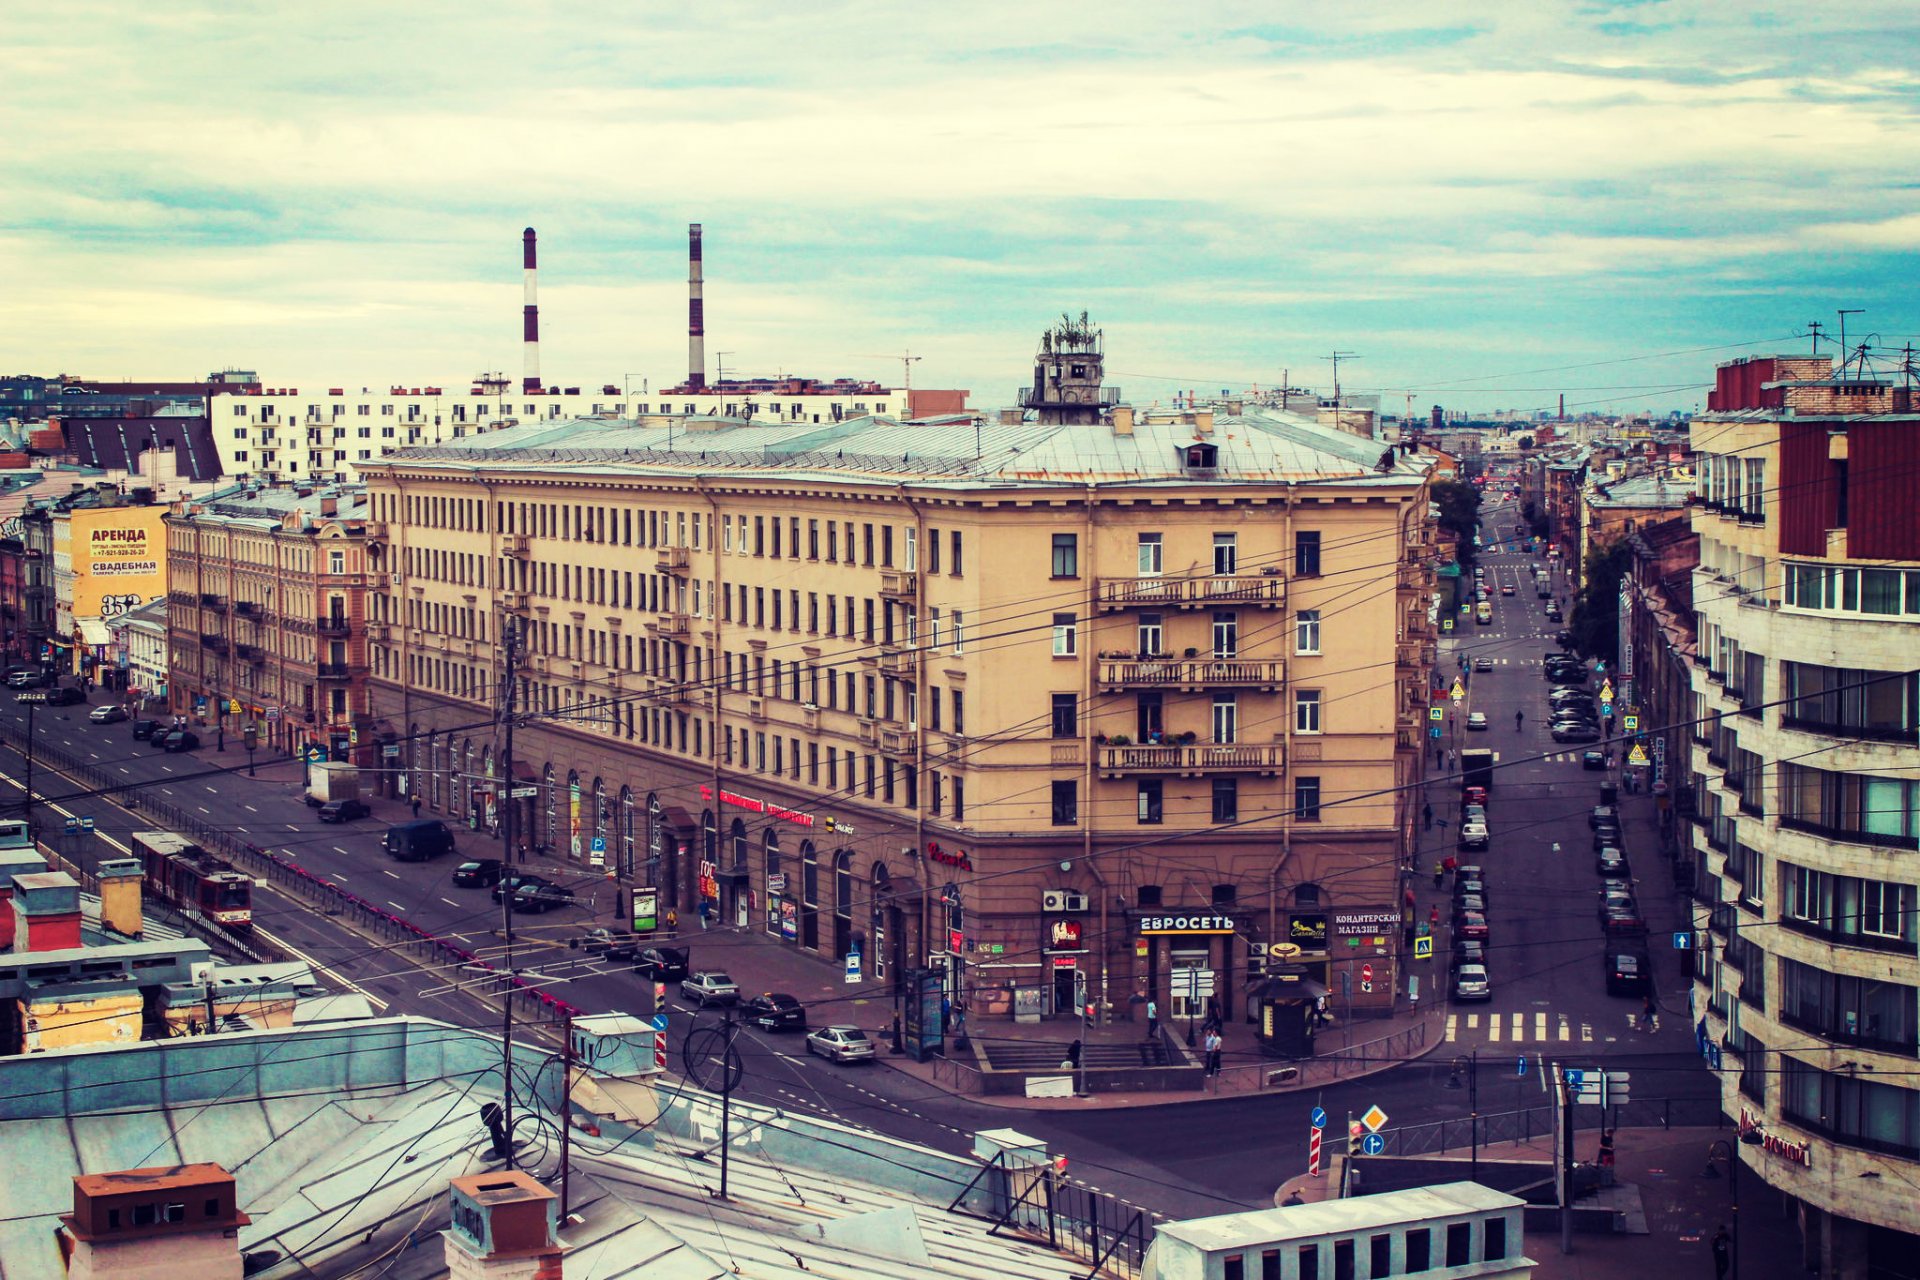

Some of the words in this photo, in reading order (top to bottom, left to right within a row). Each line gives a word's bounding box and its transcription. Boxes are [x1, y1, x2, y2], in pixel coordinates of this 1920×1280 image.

[92, 530, 146, 542] АРЕНДА
[93, 562, 156, 571] СВАДЕБНАЯ
[1141, 916, 1235, 930] ЕВРОСЕТЬ
[1335, 913, 1402, 924] КОНДИТЕРСКИЙ
[1338, 925, 1379, 934] МАГАЗИН
